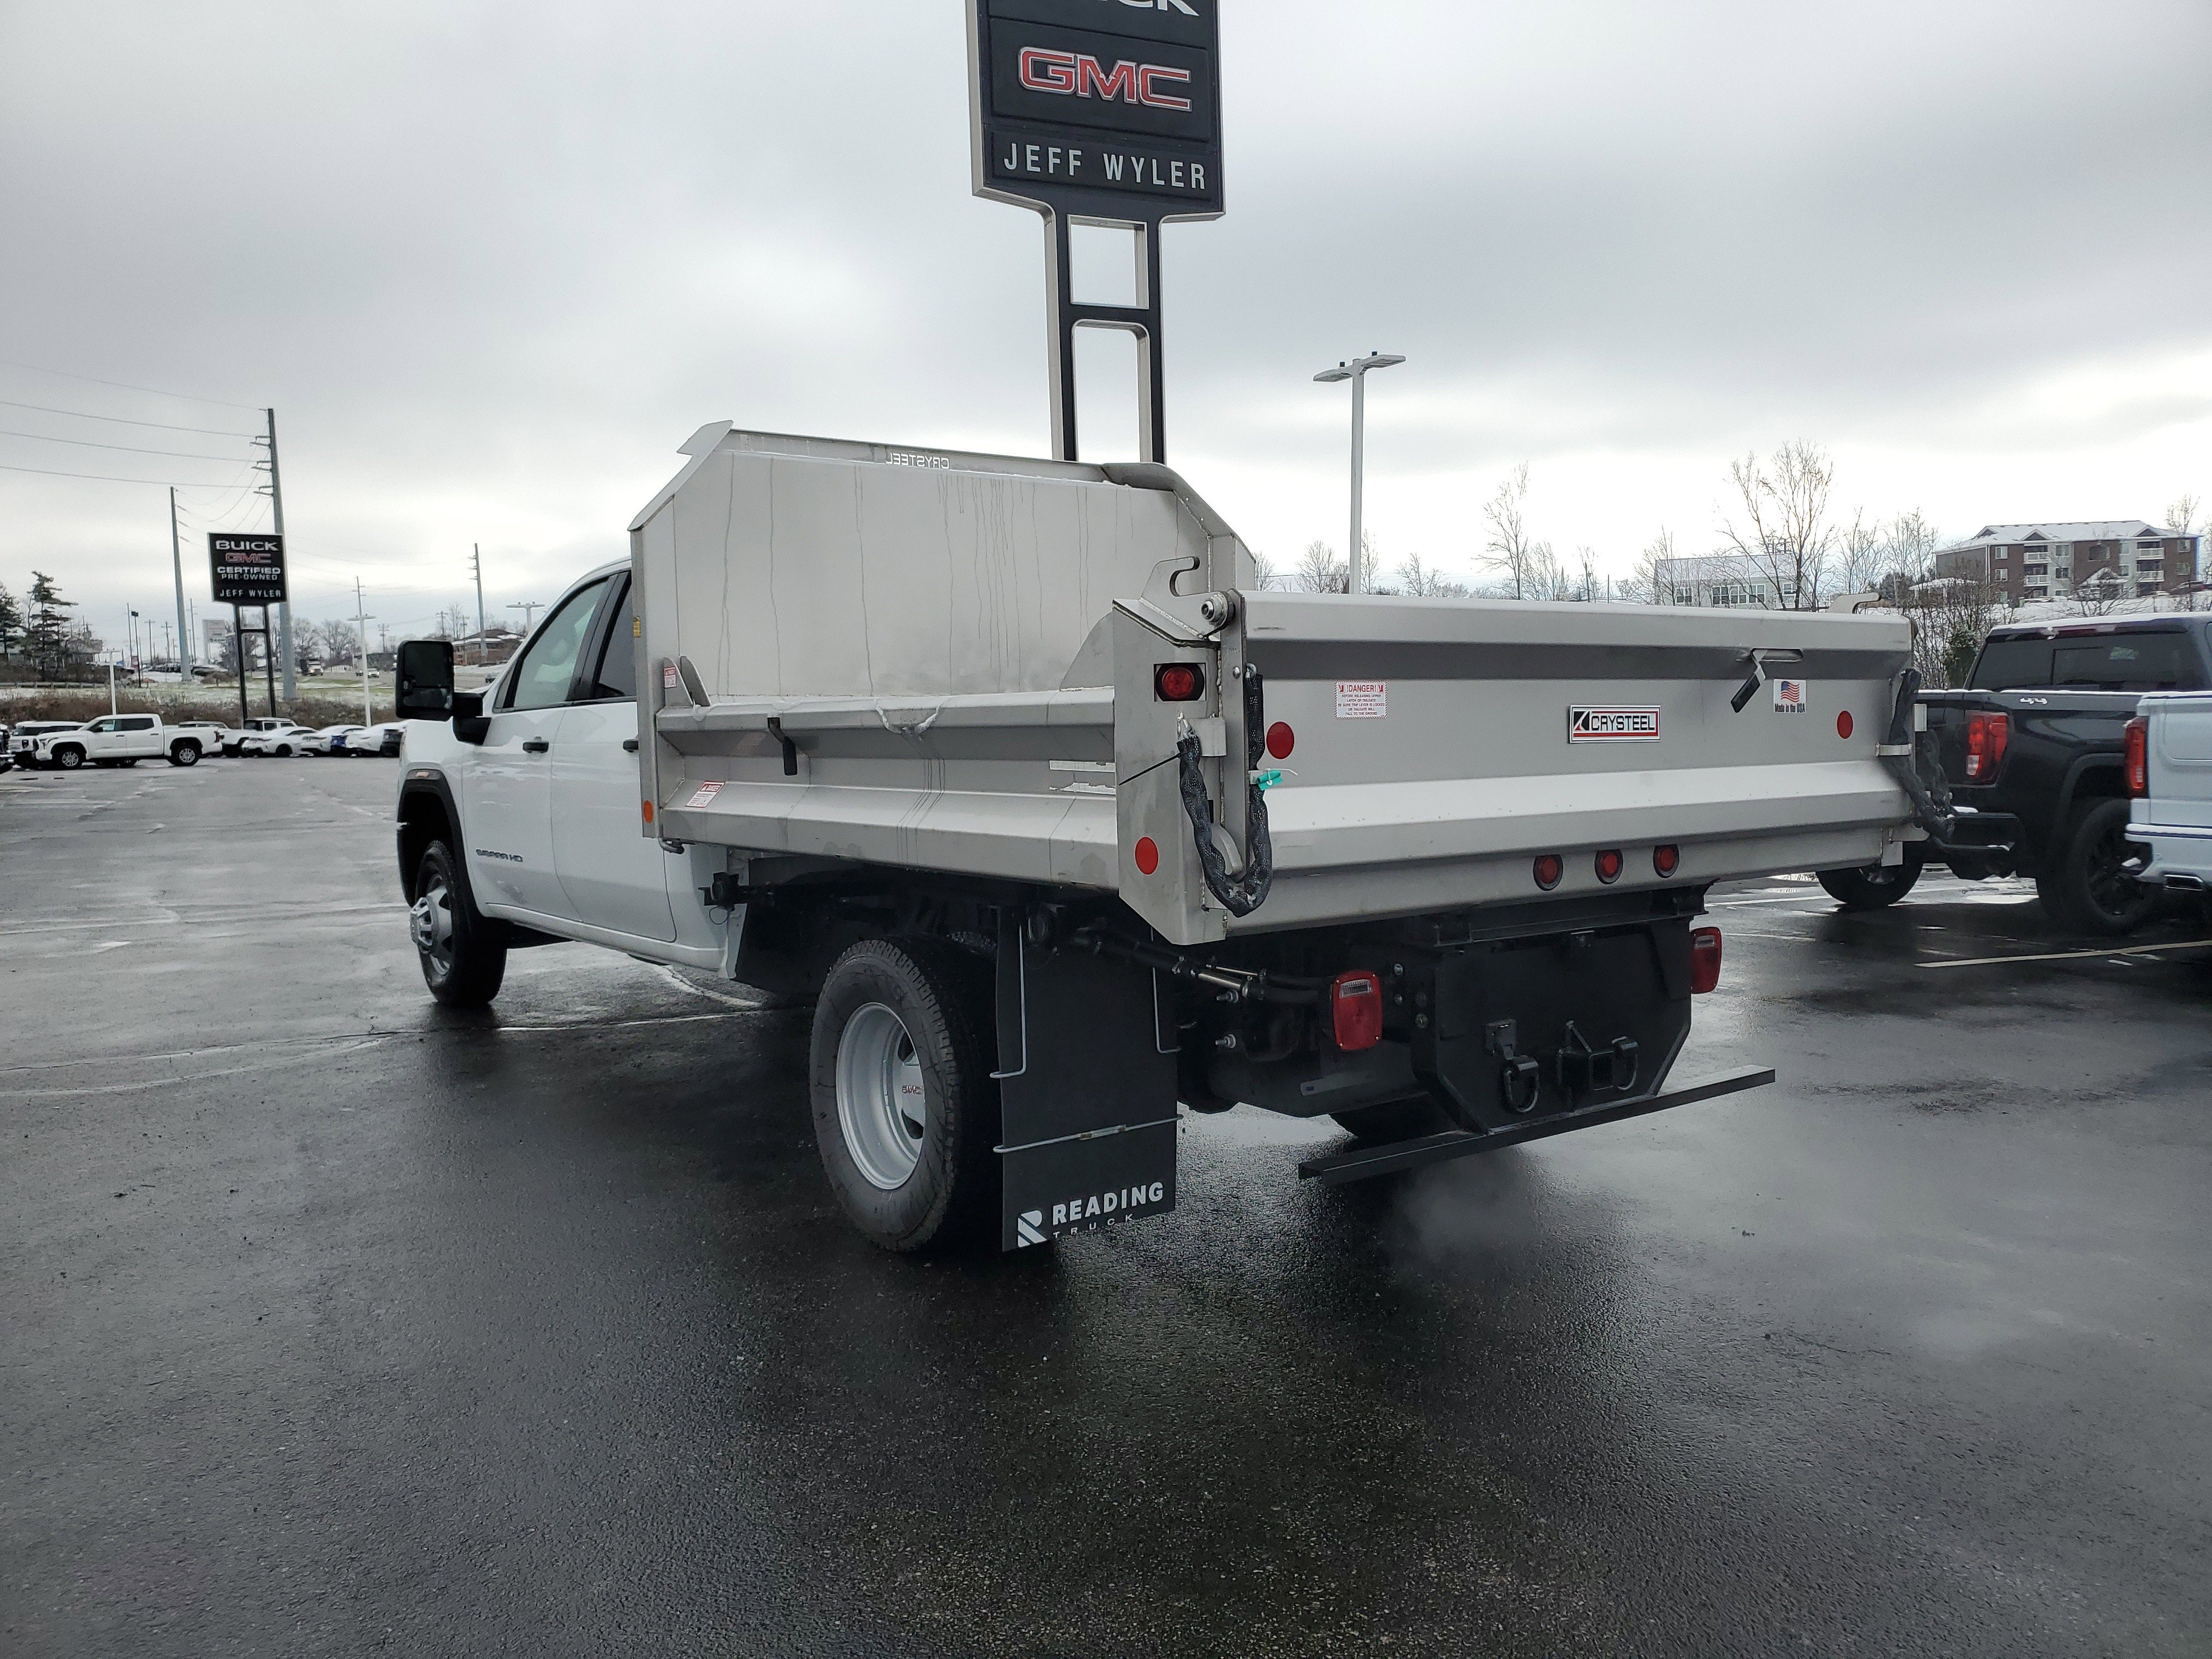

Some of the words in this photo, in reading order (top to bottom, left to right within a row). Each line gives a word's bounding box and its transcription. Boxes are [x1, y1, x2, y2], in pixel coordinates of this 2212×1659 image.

[1018, 46, 1192, 112] GMC
[1004, 143, 1082, 176] JEFF
[1103, 153, 1205, 189] WYLER
[216, 540, 278, 551] BUICK
[225, 552, 272, 563] GMC
[217, 566, 281, 574] CERTIFIED
[249, 589, 281, 597] WYLER
[1797, 703, 1805, 713] USA
[1591, 715, 1655, 731] CRYSTEEL
[1052, 1182, 1164, 1226] READING
[1052, 1213, 1133, 1239] TRUCK
